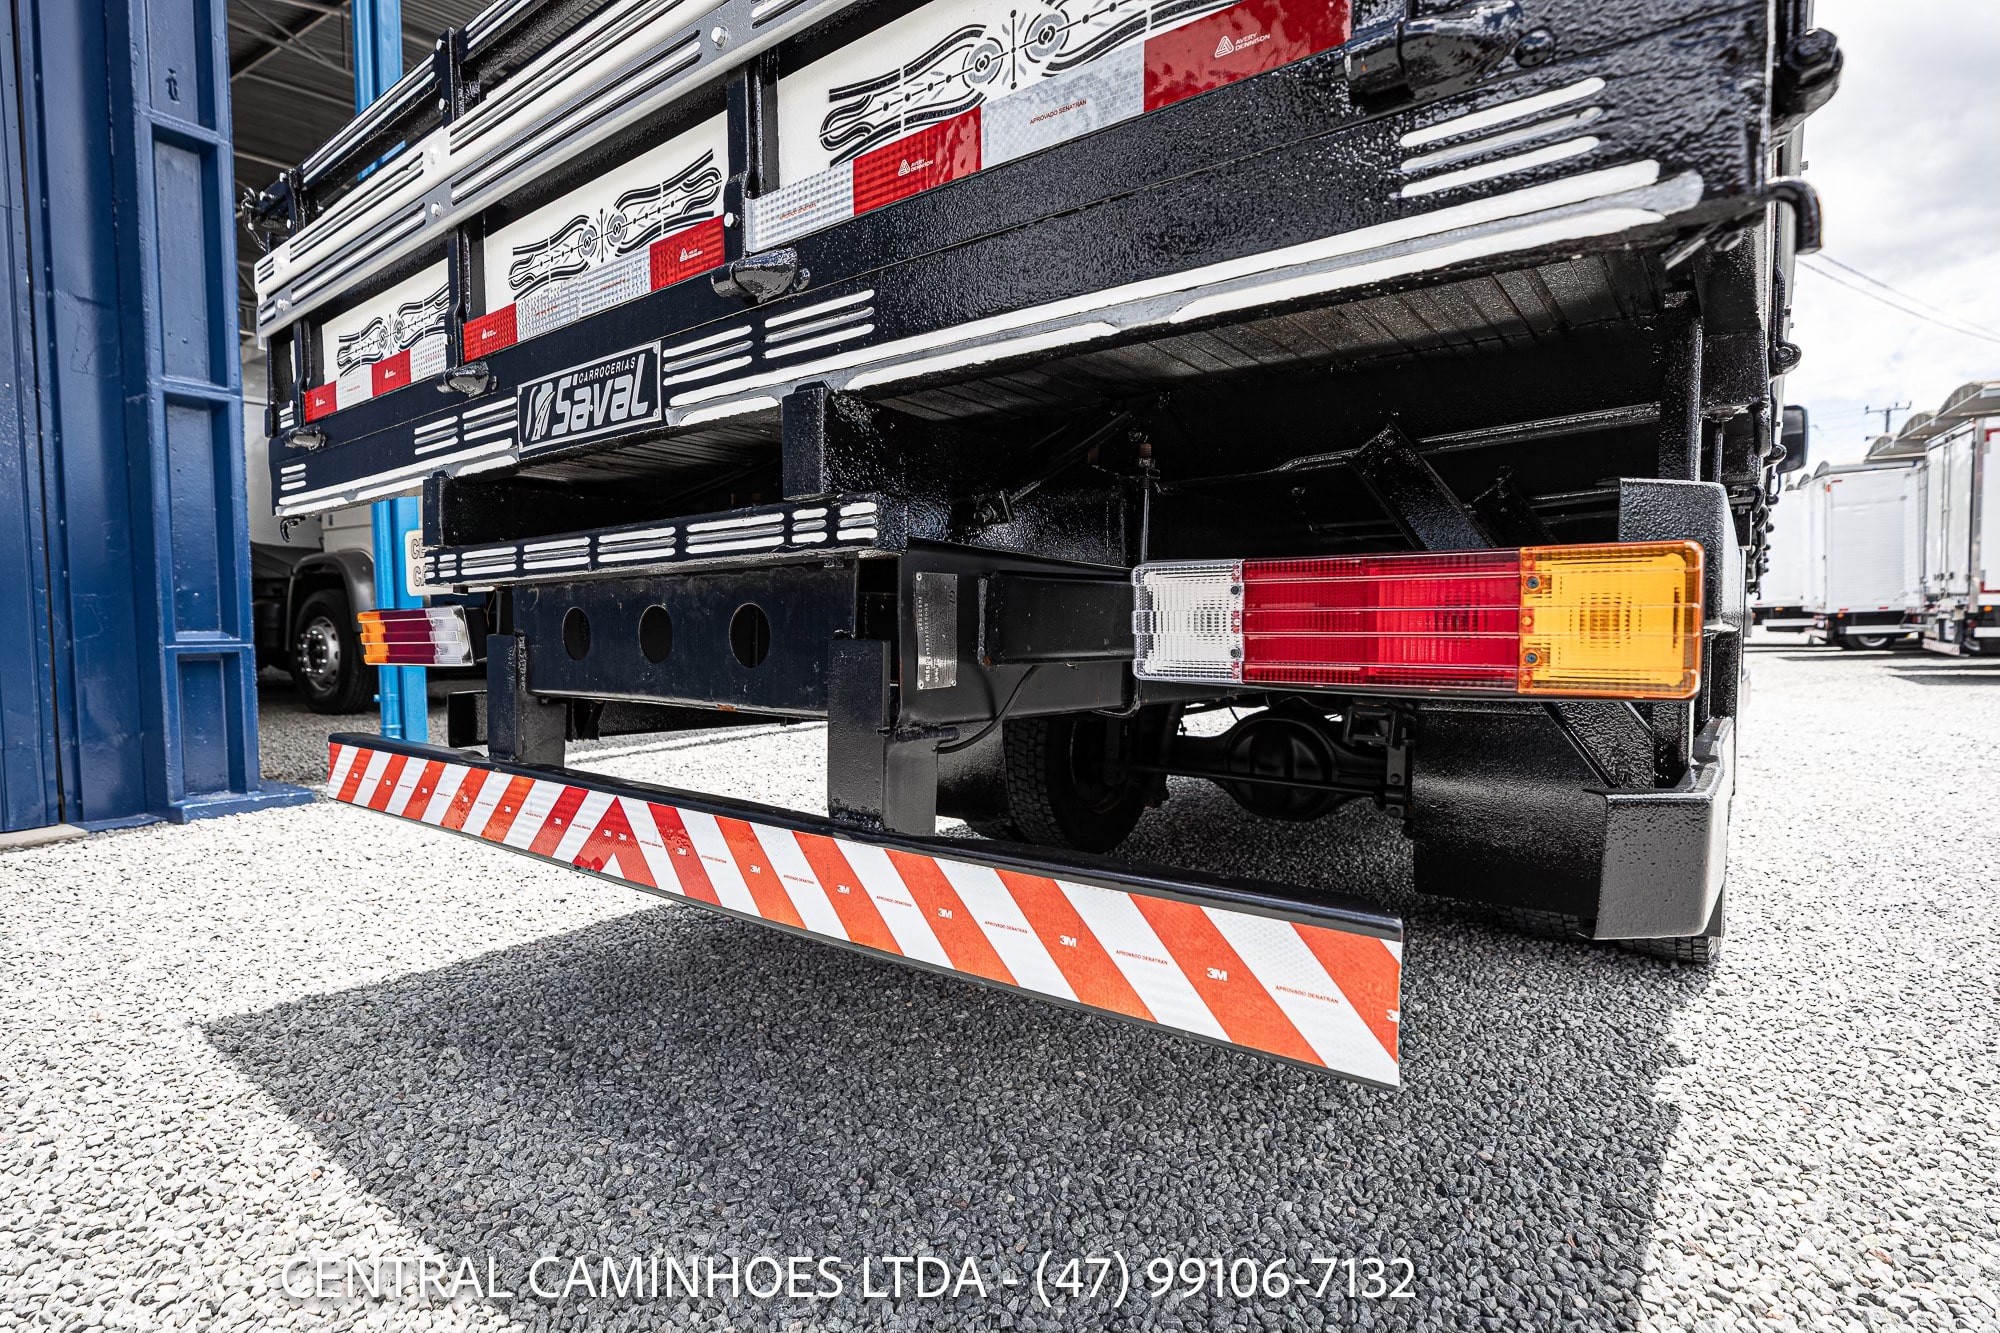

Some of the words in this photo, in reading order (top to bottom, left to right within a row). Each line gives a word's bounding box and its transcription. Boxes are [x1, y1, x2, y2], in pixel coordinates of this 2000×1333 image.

[1235, 32, 1258, 46] AVERY
[1235, 33, 1271, 52] DENNISON
[1029, 109, 1059, 126] APROVADO
[1059, 98, 1088, 115] SENATRAN
[578, 356, 637, 384] CARROCERIAS
[618, 832, 628, 842] 3M
[750, 864, 761, 875] 3M
[837, 884, 851, 895] 3M
[937, 907, 954, 920] 3M
[1059, 934, 1078, 948] 3M
[1115, 948, 1142, 960] APROVADO
[1142, 953, 1168, 966] DENATRAN
[1205, 966, 1229, 982] 3M
[1275, 984, 1307, 997] APROVADO
[1307, 991, 1339, 1005] DENATRAN
